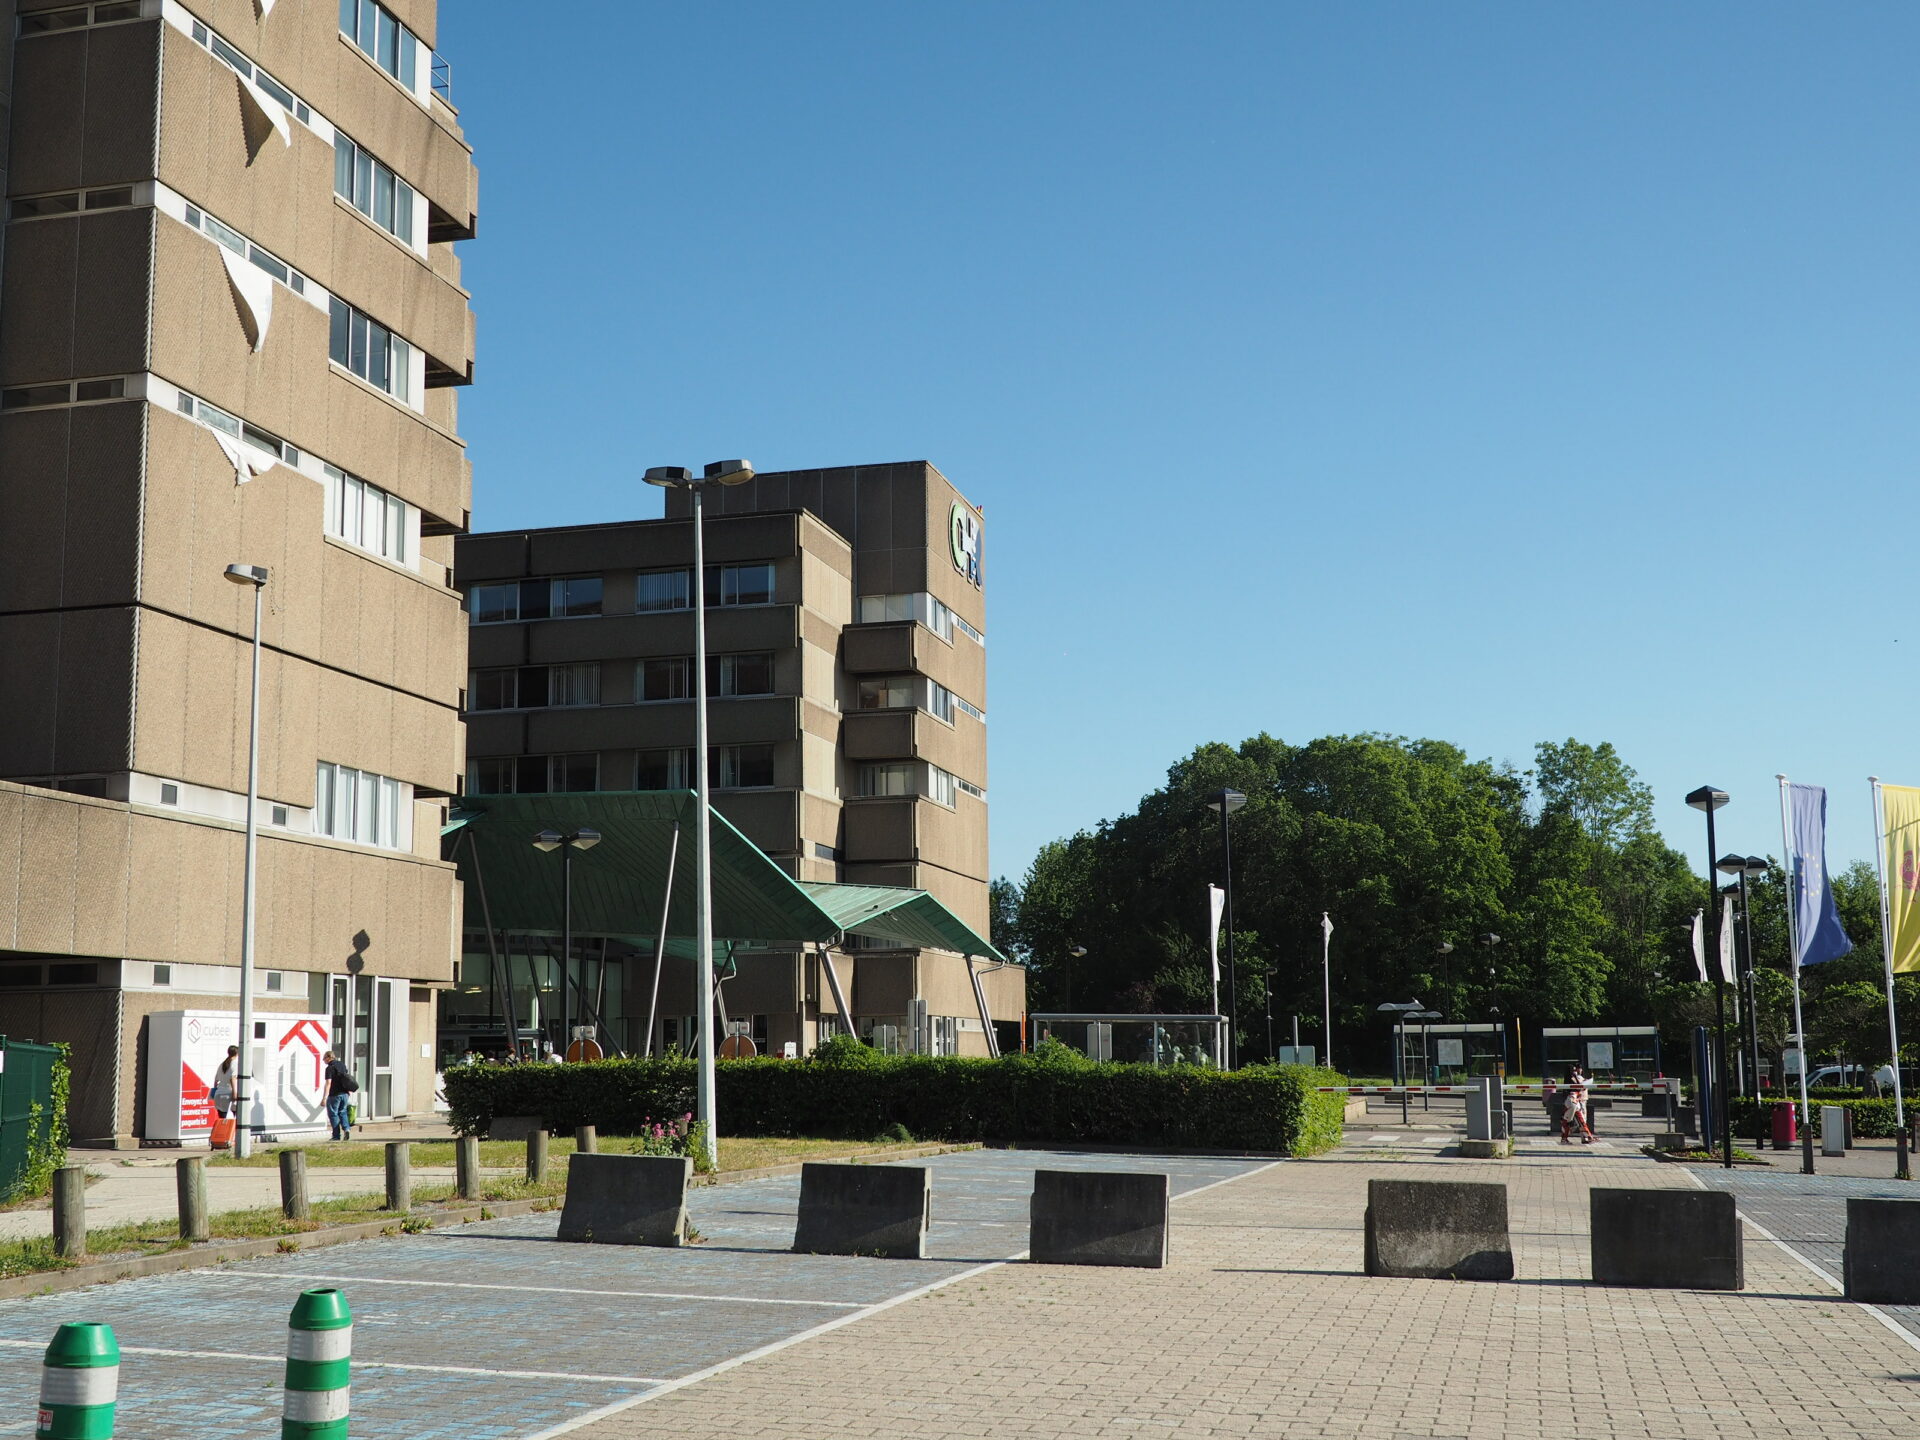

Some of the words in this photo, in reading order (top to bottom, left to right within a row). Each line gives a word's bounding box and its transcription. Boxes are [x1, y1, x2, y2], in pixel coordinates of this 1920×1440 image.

[203, 1025, 231, 1036] cubee
[182, 1097, 202, 1106] Envoyez
[182, 1118, 201, 1127] paquets
